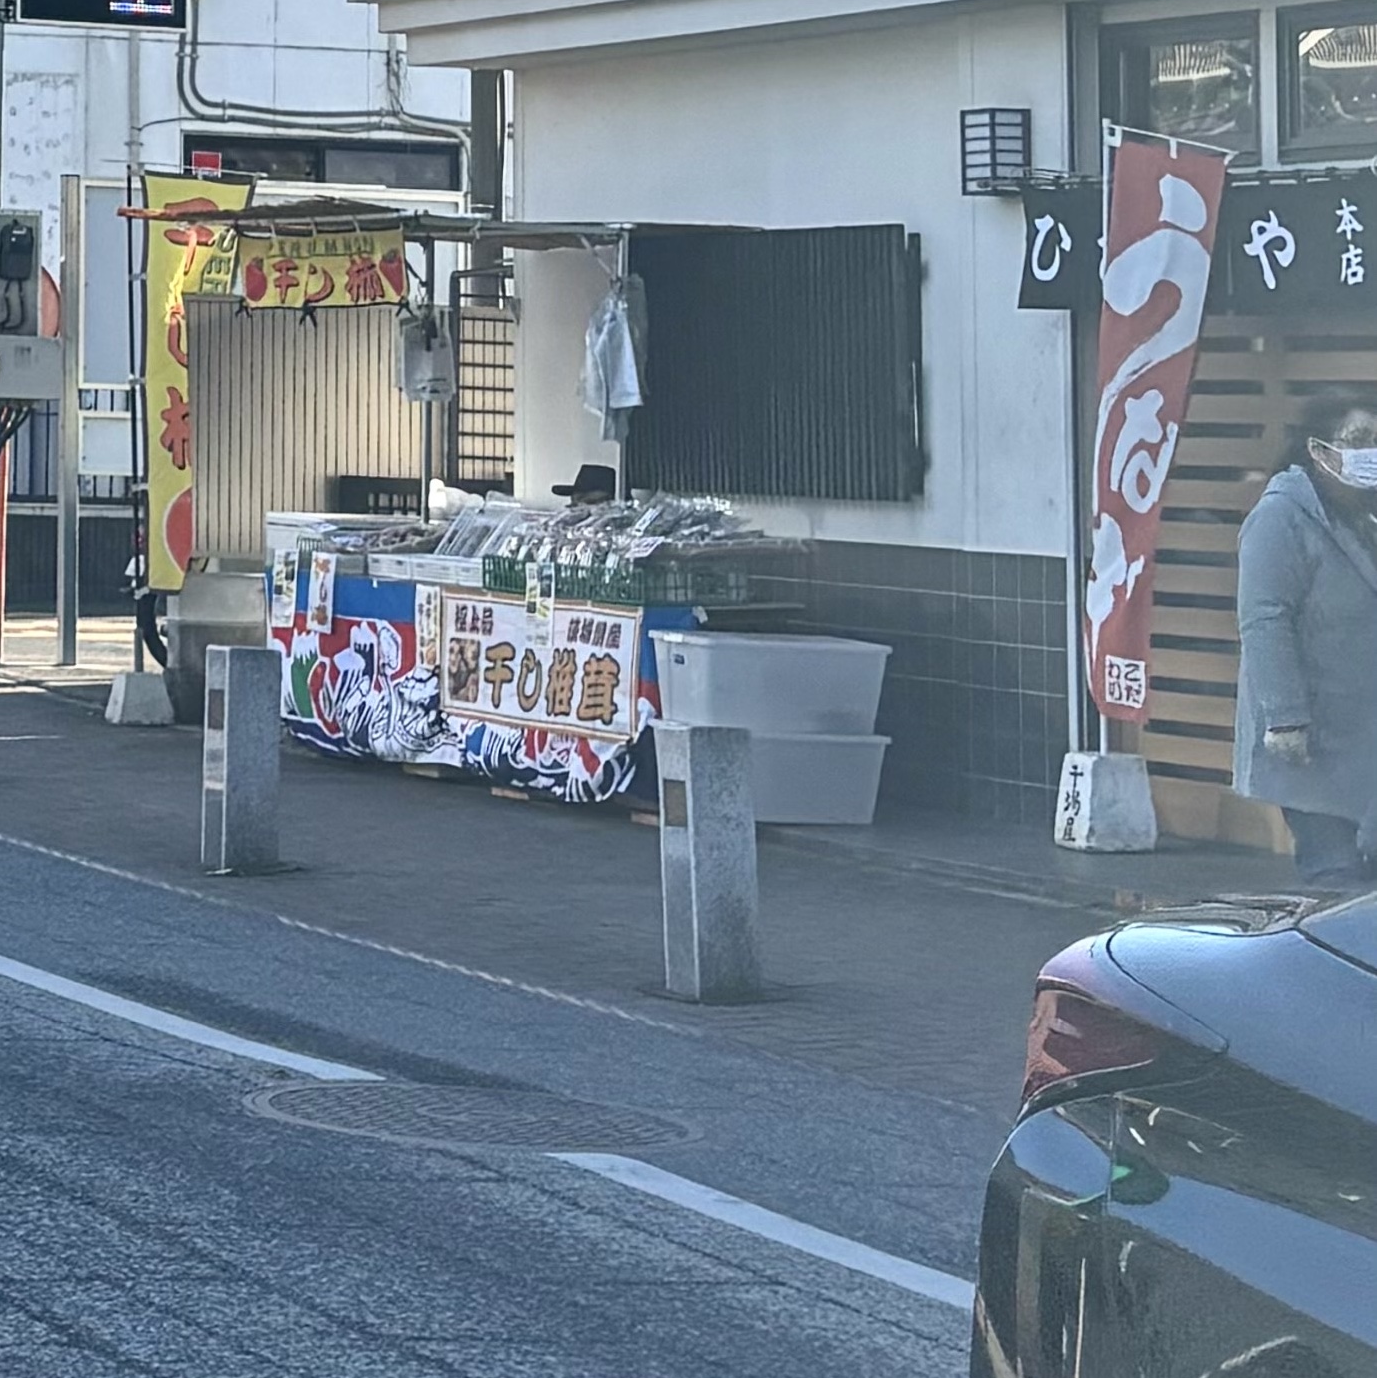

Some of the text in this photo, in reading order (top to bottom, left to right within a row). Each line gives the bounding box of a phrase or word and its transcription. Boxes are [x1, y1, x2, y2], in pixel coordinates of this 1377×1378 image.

[1334, 197, 1365, 286] 本店
[483, 641, 621, 726] 干し椎茸
